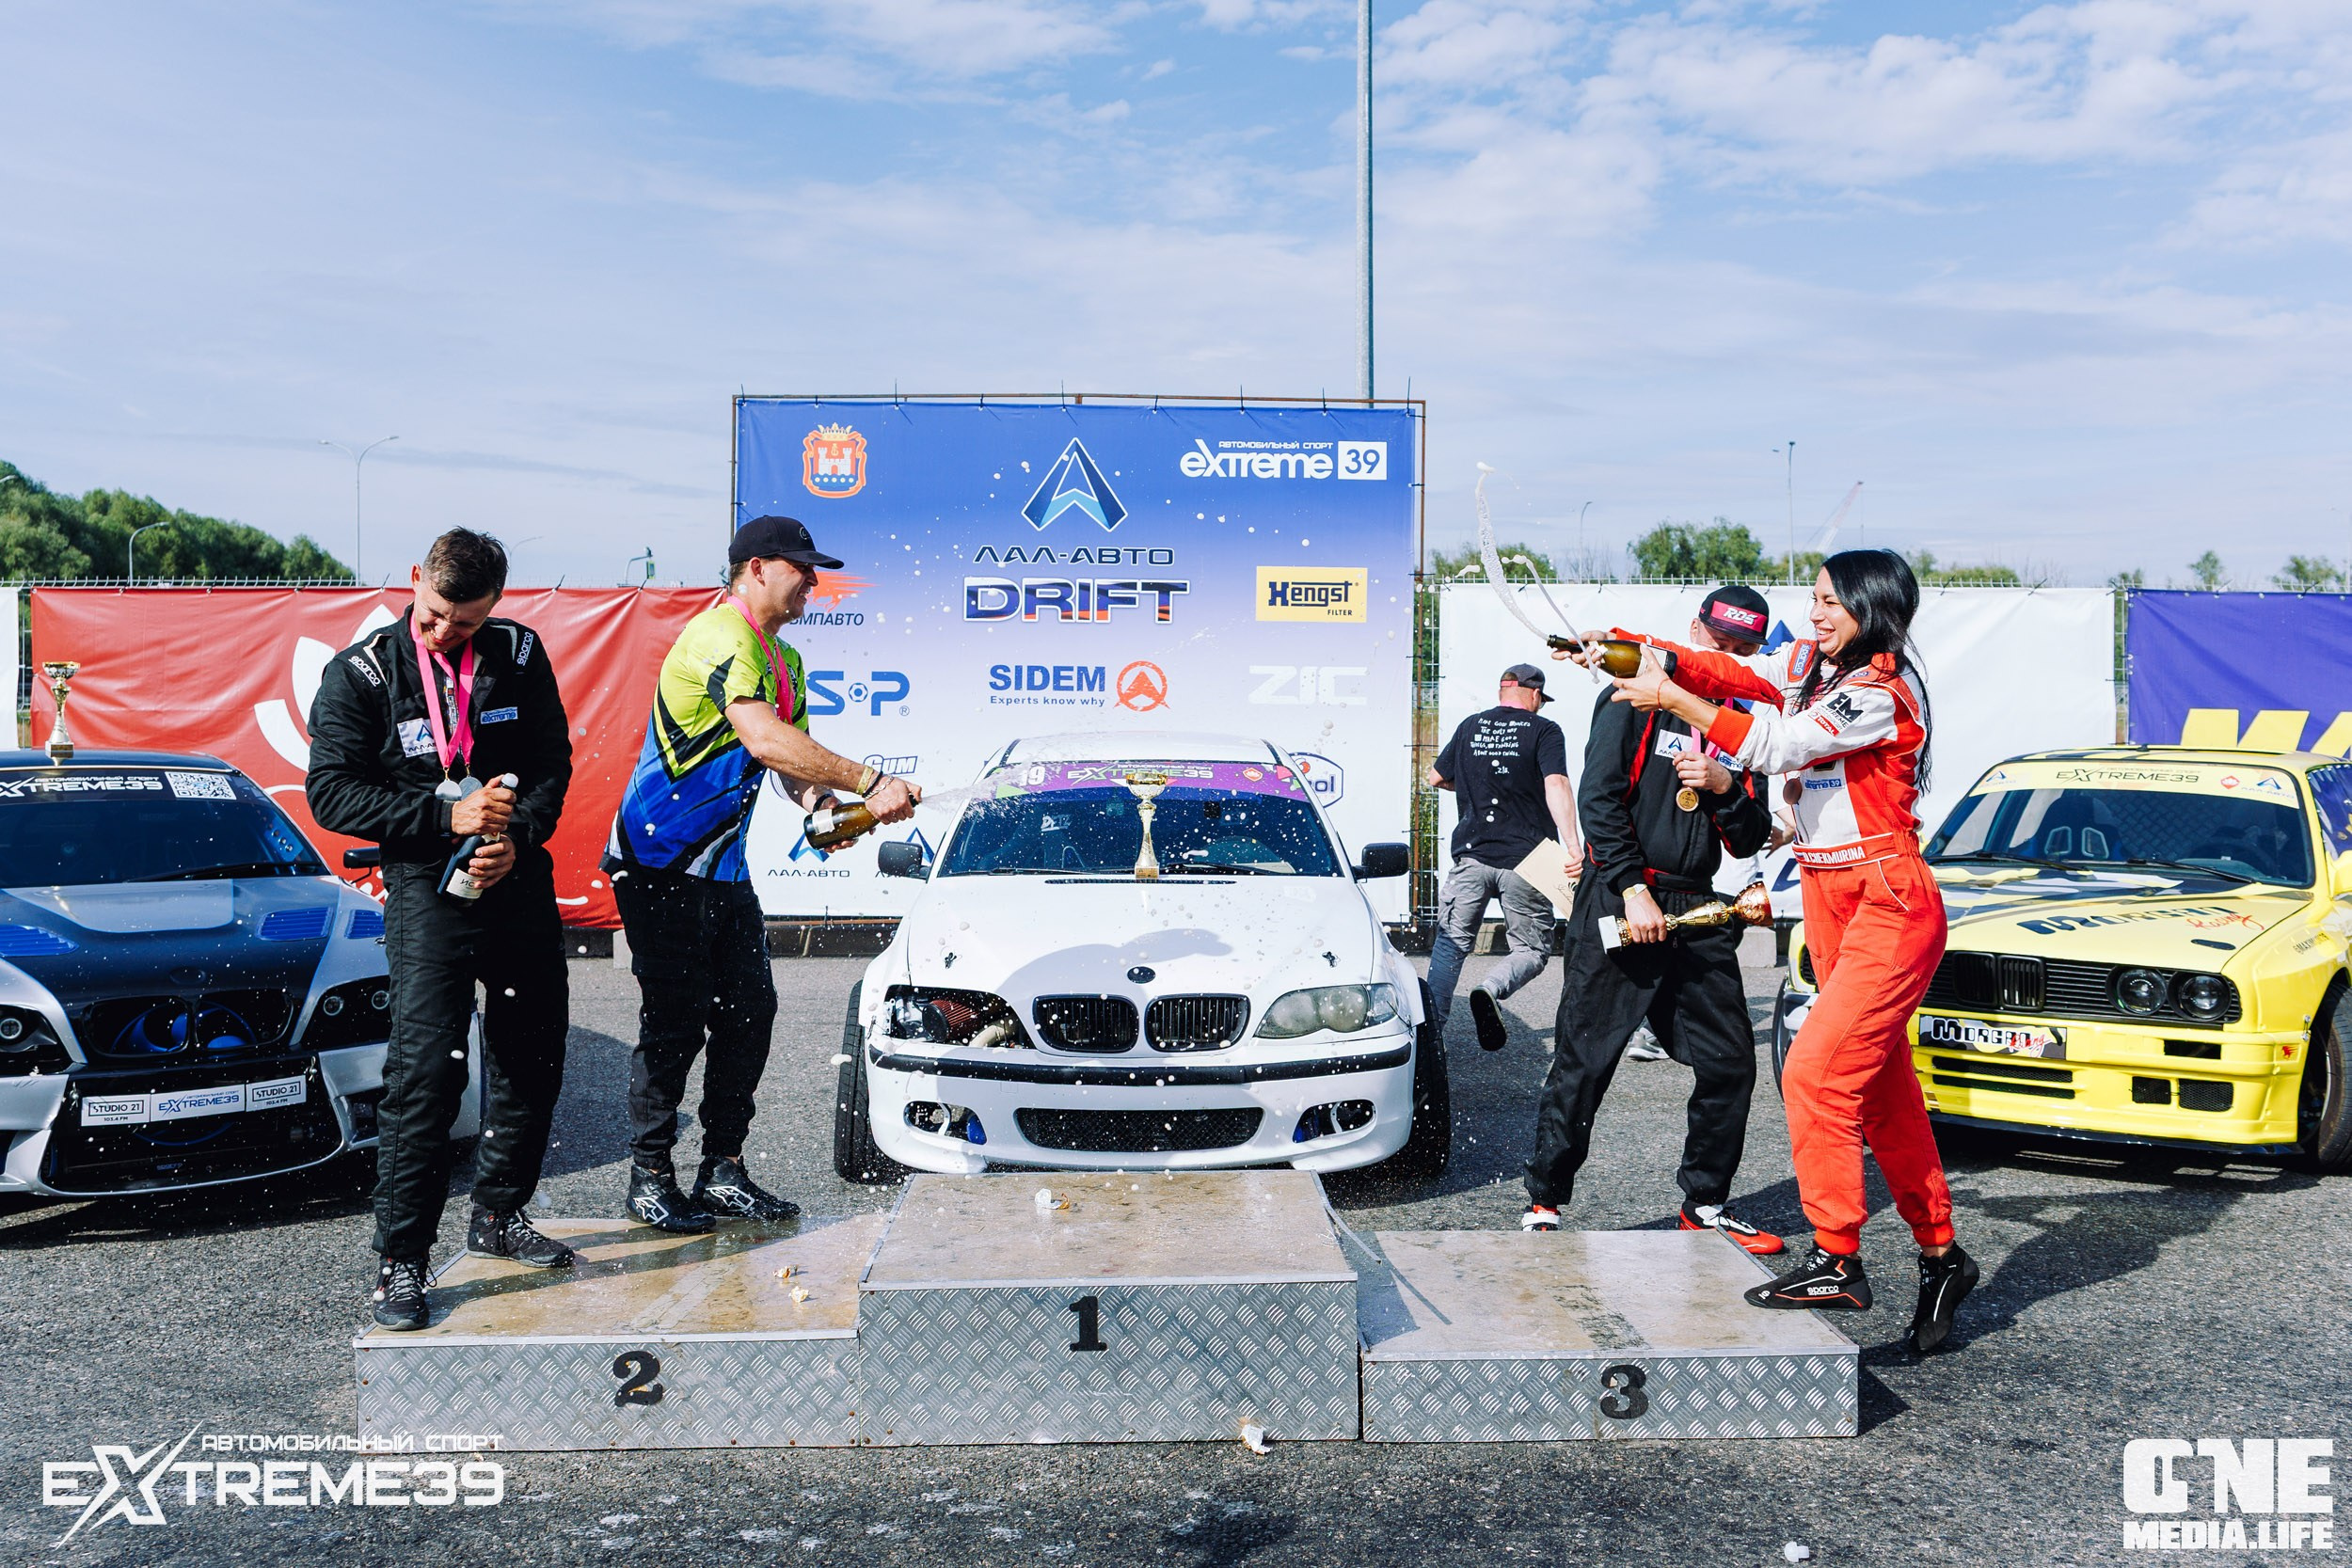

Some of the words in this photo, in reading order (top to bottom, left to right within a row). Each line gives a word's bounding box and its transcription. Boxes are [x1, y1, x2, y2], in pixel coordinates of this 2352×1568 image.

[1218, 440, 1299, 450] АВТОМОБИЛЬНЫЙ
[1303, 441, 1333, 450] СПОРТ
[1344, 449, 1380, 475] 39
[963, 577, 1190, 624] DRIFT
[1268, 580, 1353, 607] Hengst
[1724, 607, 1758, 626] RDS
[517, 631, 534, 667] sparco
[348, 656, 381, 687] sparco
[989, 664, 1106, 692] SIDEM
[1249, 665, 1367, 705] ZIC
[990, 695, 1039, 706] Experts
[1043, 696, 1075, 705] know
[1080, 697, 1105, 707] why
[1817, 715, 1837, 736] TOTAL
[2057, 768, 2200, 783] EXTREME39
[159, 1094, 240, 1117] EXTREME39
[257, 1086, 287, 1099] STUDIO
[93, 1103, 128, 1114] STUDIO
[131, 1103, 140, 1112] 21
[1807, 1285, 1839, 1296] sparco
[1069, 1295, 1107, 1353] 1
[612, 1350, 663, 1407] 2
[1600, 1365, 1648, 1419] 3
